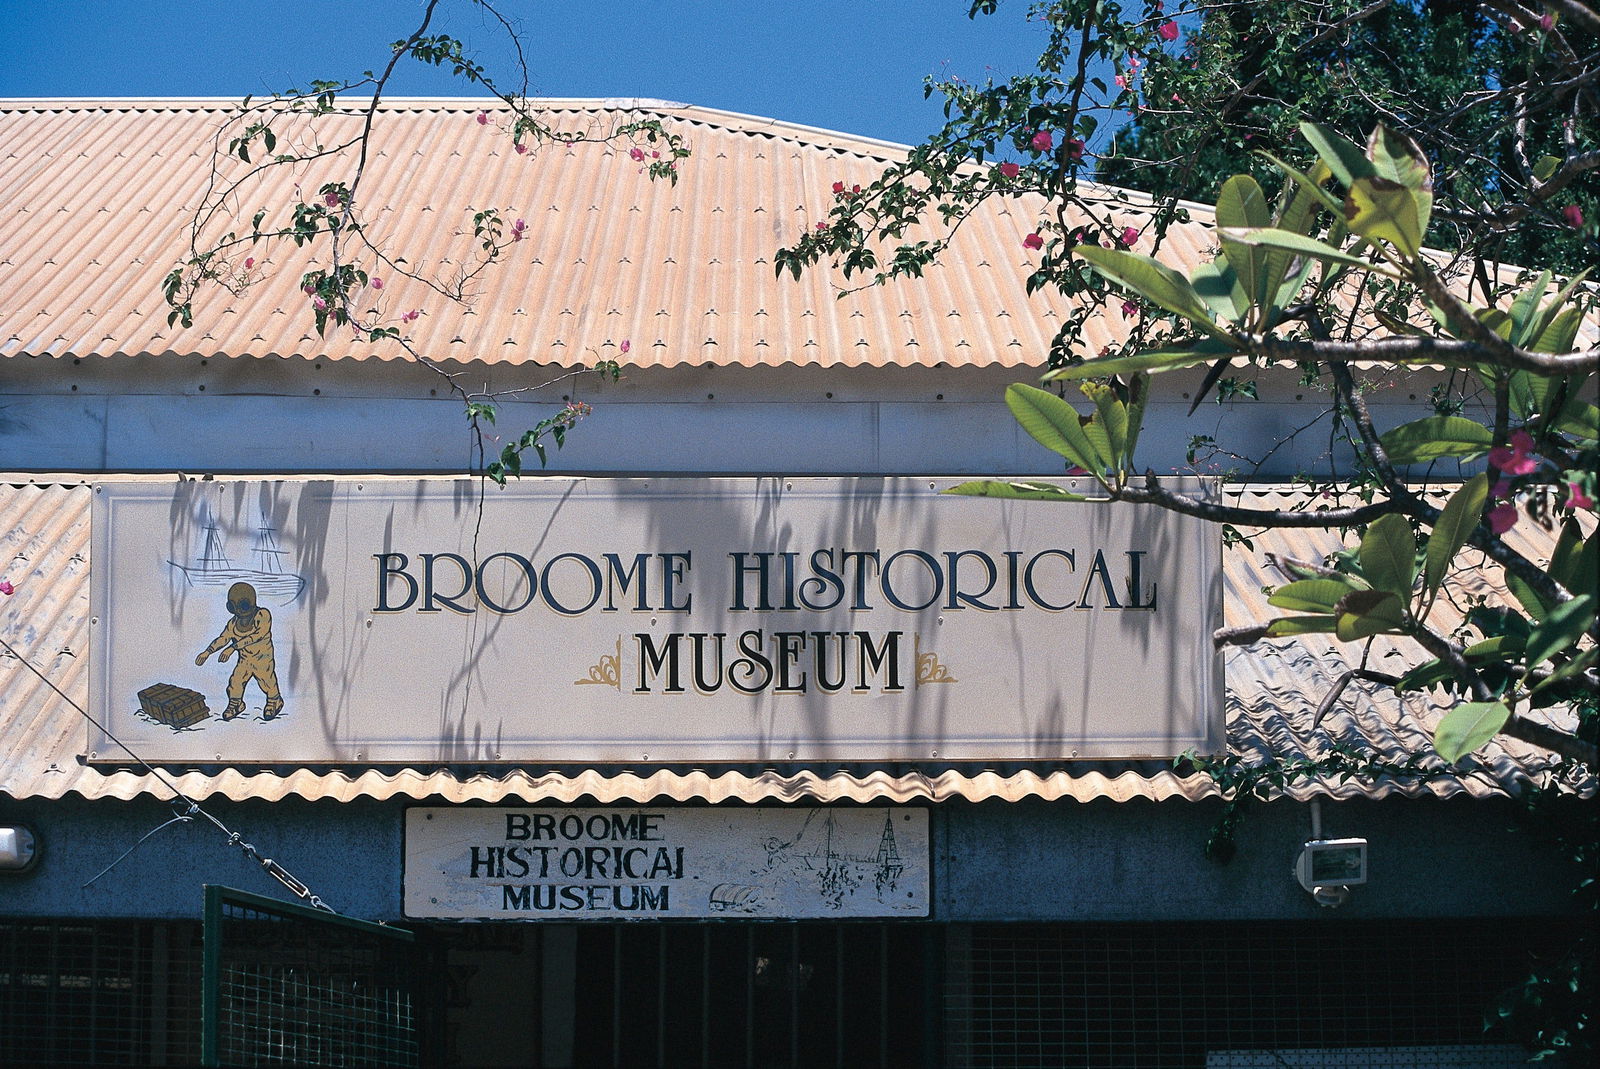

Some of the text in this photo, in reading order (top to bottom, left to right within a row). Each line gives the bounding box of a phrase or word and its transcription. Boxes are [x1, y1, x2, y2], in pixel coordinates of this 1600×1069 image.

[371, 547, 1157, 616] BROOME HISTORICAL
[632, 628, 905, 696] MUSEUM
[505, 813, 665, 841] BROOME
[502, 884, 669, 911] MUSEUM
